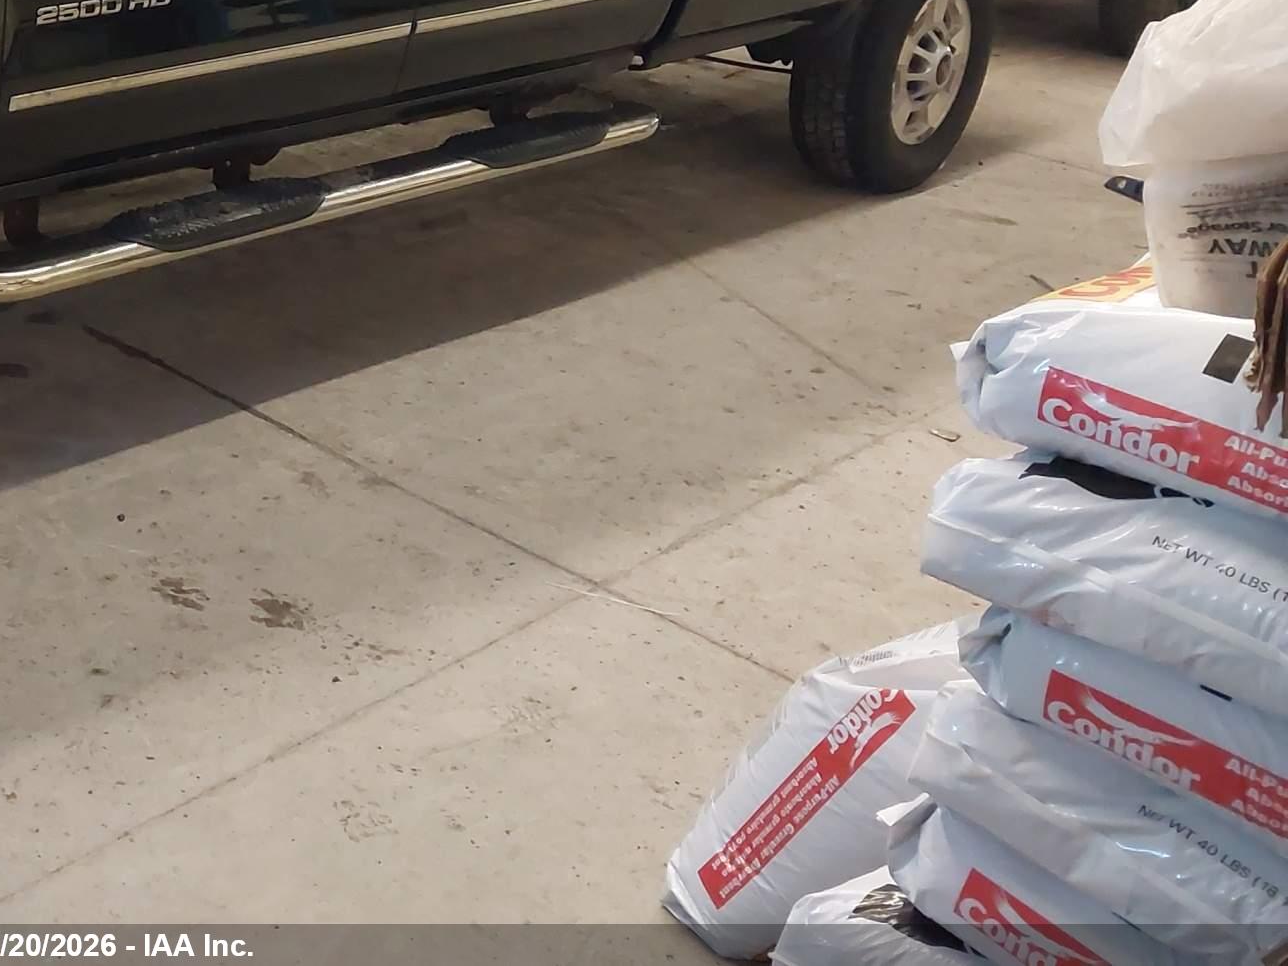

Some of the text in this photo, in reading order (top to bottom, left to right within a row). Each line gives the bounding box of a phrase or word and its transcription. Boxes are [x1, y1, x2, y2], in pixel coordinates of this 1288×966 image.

[1042, 398, 1201, 475] Condor
[1185, 548, 1214, 567] WT
[1239, 572, 1271, 594] LBS
[1046, 700, 1201, 792] Condor
[1169, 818, 1197, 839] WT
[1197, 839, 1219, 856] 40
[1220, 854, 1252, 879] LBS
